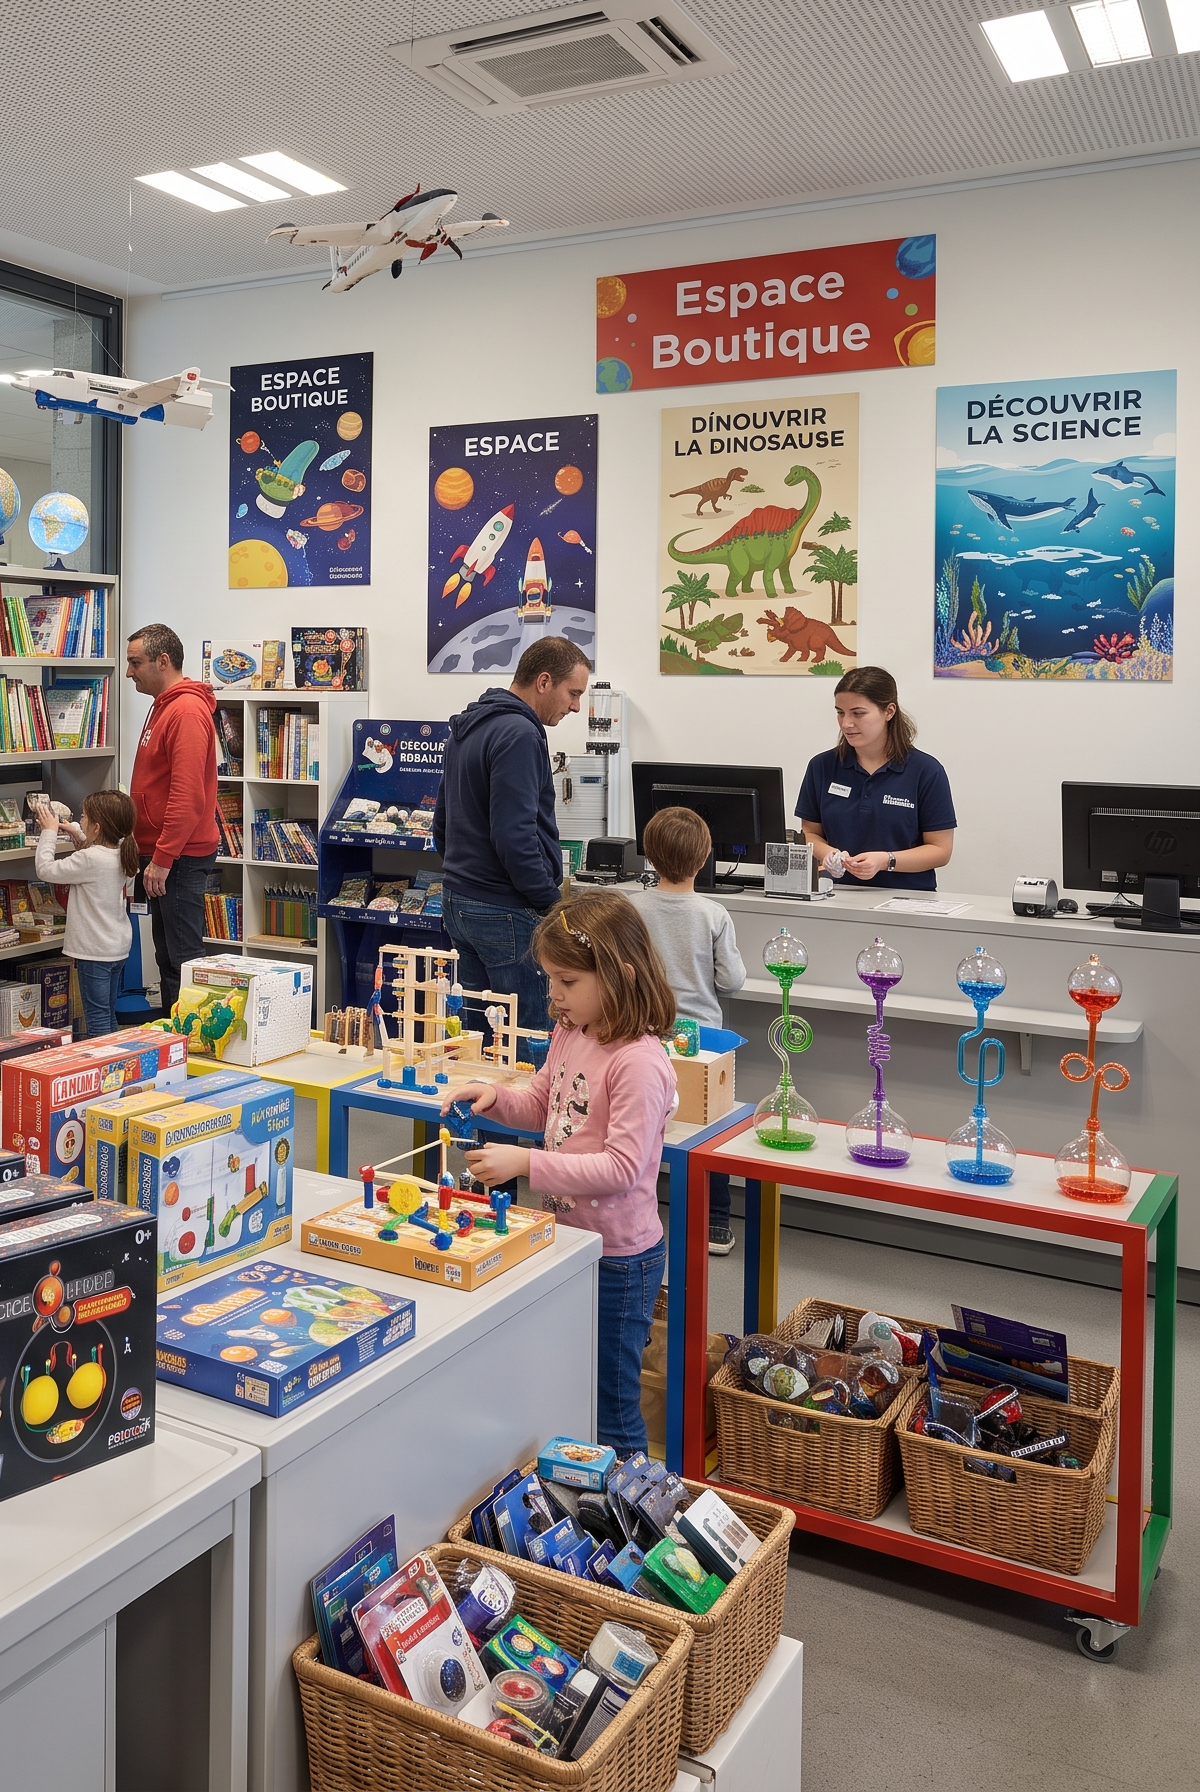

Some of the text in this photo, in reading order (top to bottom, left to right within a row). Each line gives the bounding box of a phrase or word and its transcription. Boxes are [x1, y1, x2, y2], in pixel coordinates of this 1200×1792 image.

[676, 271, 845, 318] Espace
[653, 320, 871, 370] Boutique
[261, 366, 340, 391] ESPACE
[251, 388, 349, 413] BOUTIQUE
[967, 389, 1142, 420] DÉCOUVRIR
[691, 407, 827, 434] DÍNOUVRIR
[967, 416, 1142, 446] LA SCIENCE
[465, 431, 560, 457] ESPACE
[674, 430, 845, 457] LA DINOSAUSE
